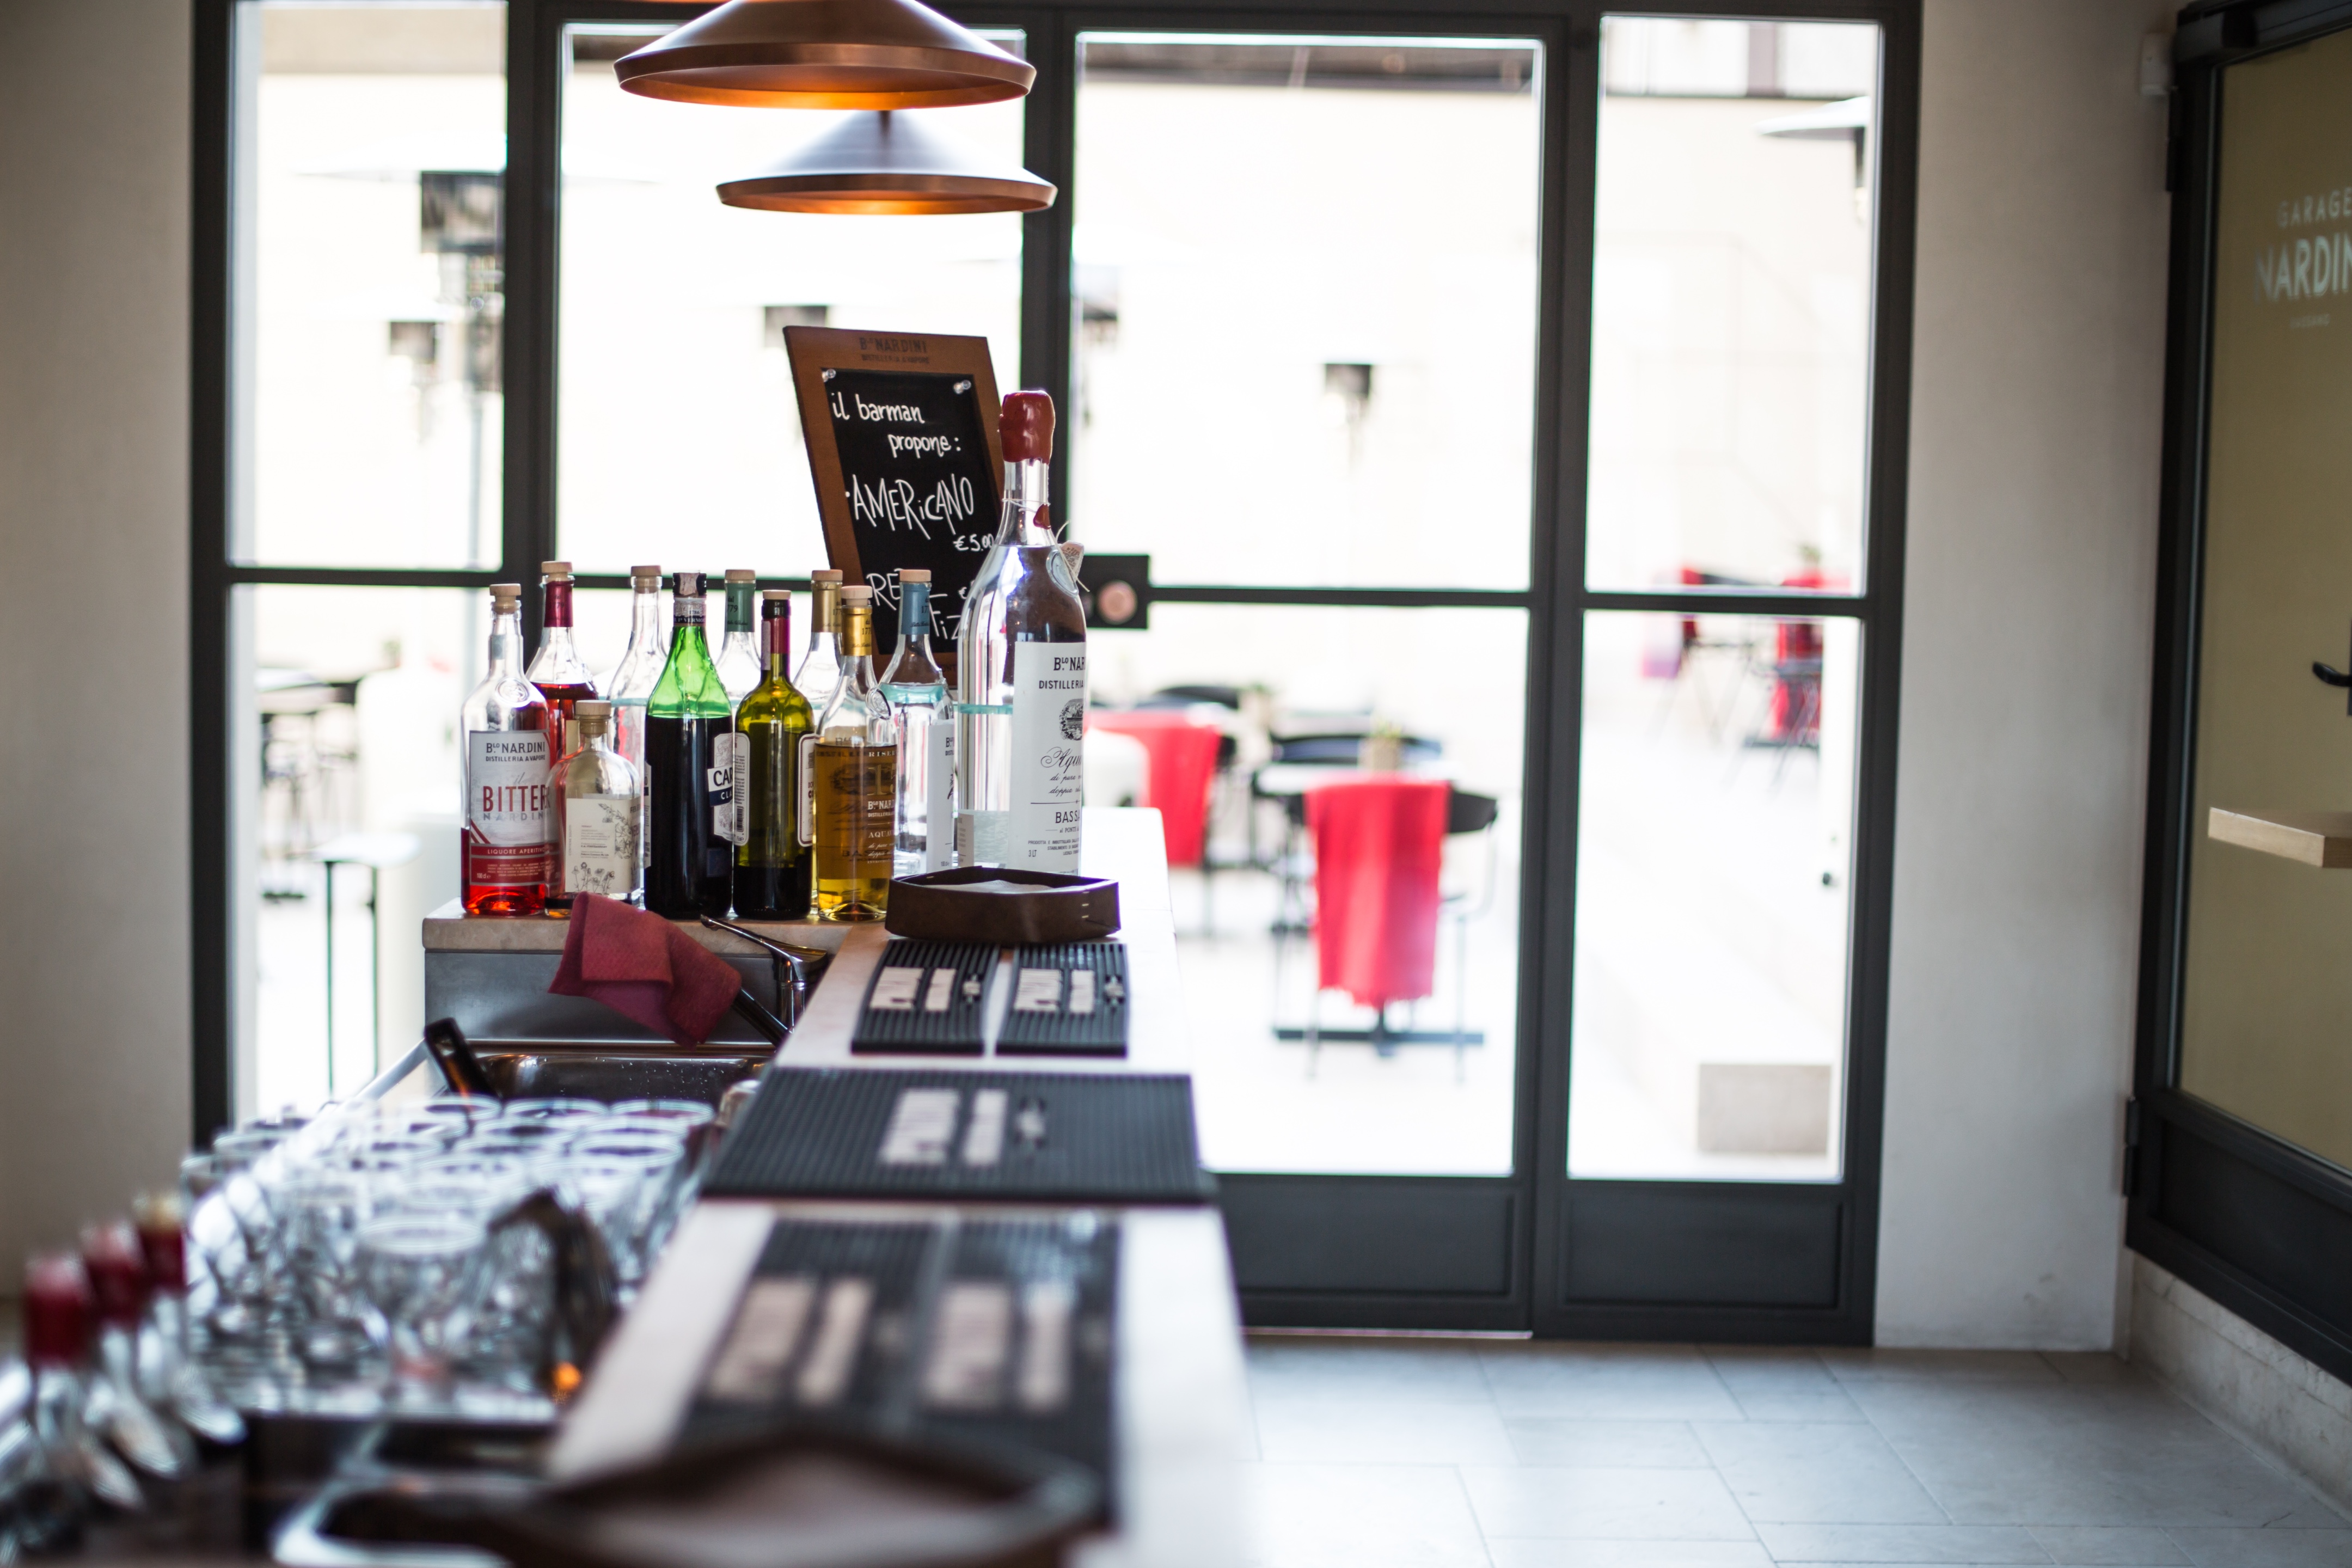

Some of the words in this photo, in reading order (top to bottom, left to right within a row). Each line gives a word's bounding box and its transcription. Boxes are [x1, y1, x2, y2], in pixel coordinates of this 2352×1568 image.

[2276, 187, 2352, 229] GARAGE
[831, 391, 850, 420] il
[855, 394, 925, 424] barman
[727, 604, 738, 612] 779
[1039, 680, 1083, 689] DISTILLERIA
[501, 742, 546, 753] NARDINI
[1050, 773, 1060, 781] di
[1048, 786, 1073, 797] doppia
[483, 784, 550, 812] BITTER
[483, 812, 543, 821] NARDIN
